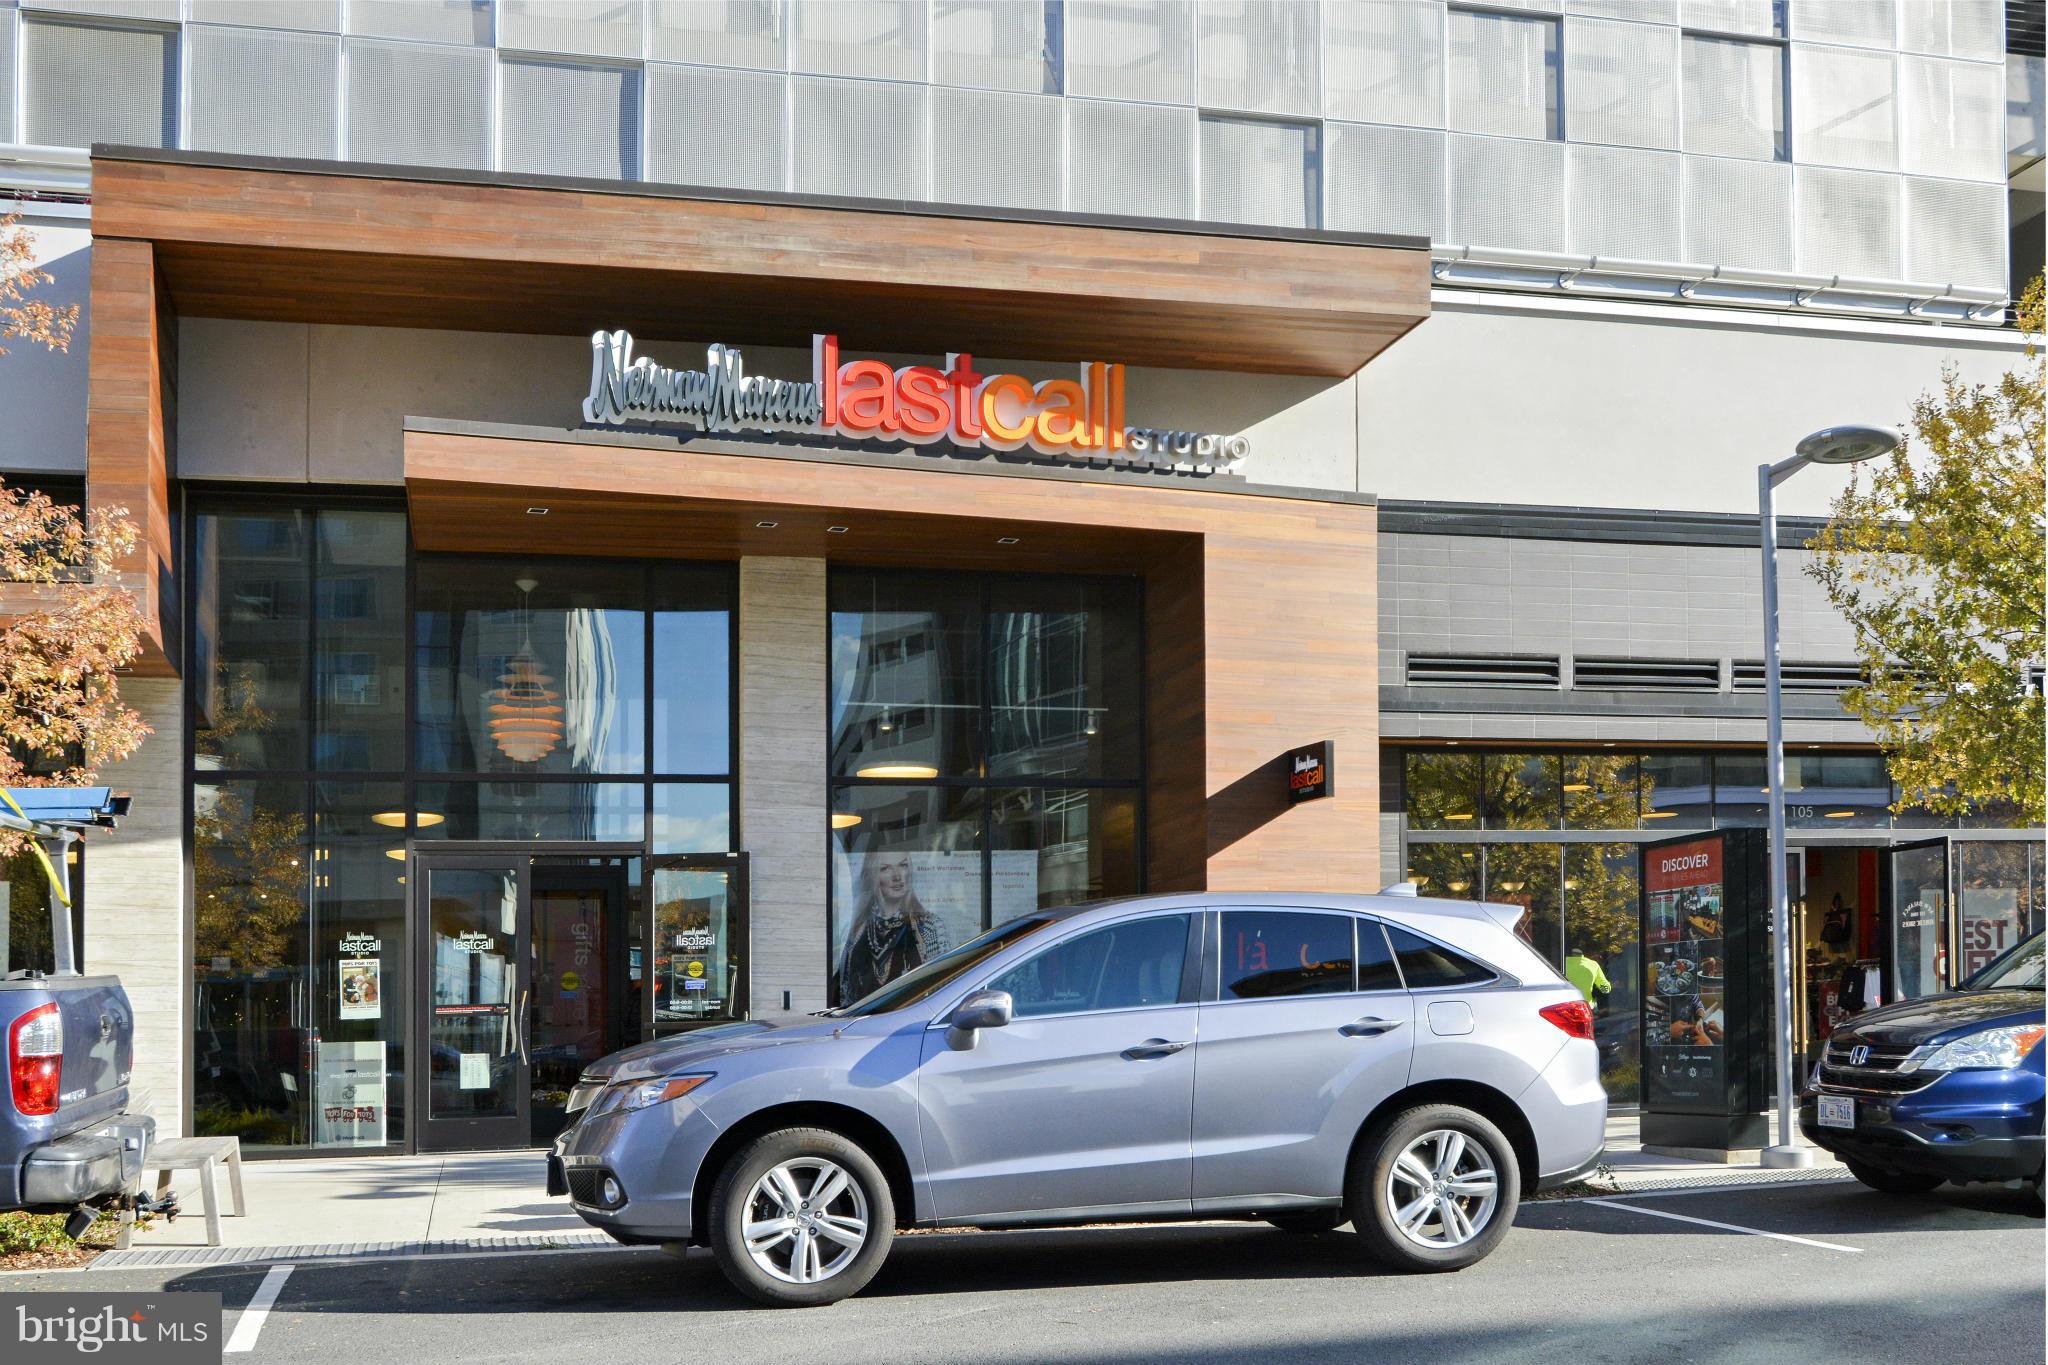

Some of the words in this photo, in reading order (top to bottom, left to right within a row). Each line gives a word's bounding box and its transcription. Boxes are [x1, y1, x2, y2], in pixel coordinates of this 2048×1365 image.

[1129, 427, 1251, 463] STUDIO
[1791, 806, 1814, 818] 105
[1662, 853, 1709, 873] DISCOVER
[339, 939, 381, 952] lastcall
[453, 938, 494, 950] lastcall
[571, 923, 593, 966] gifts
